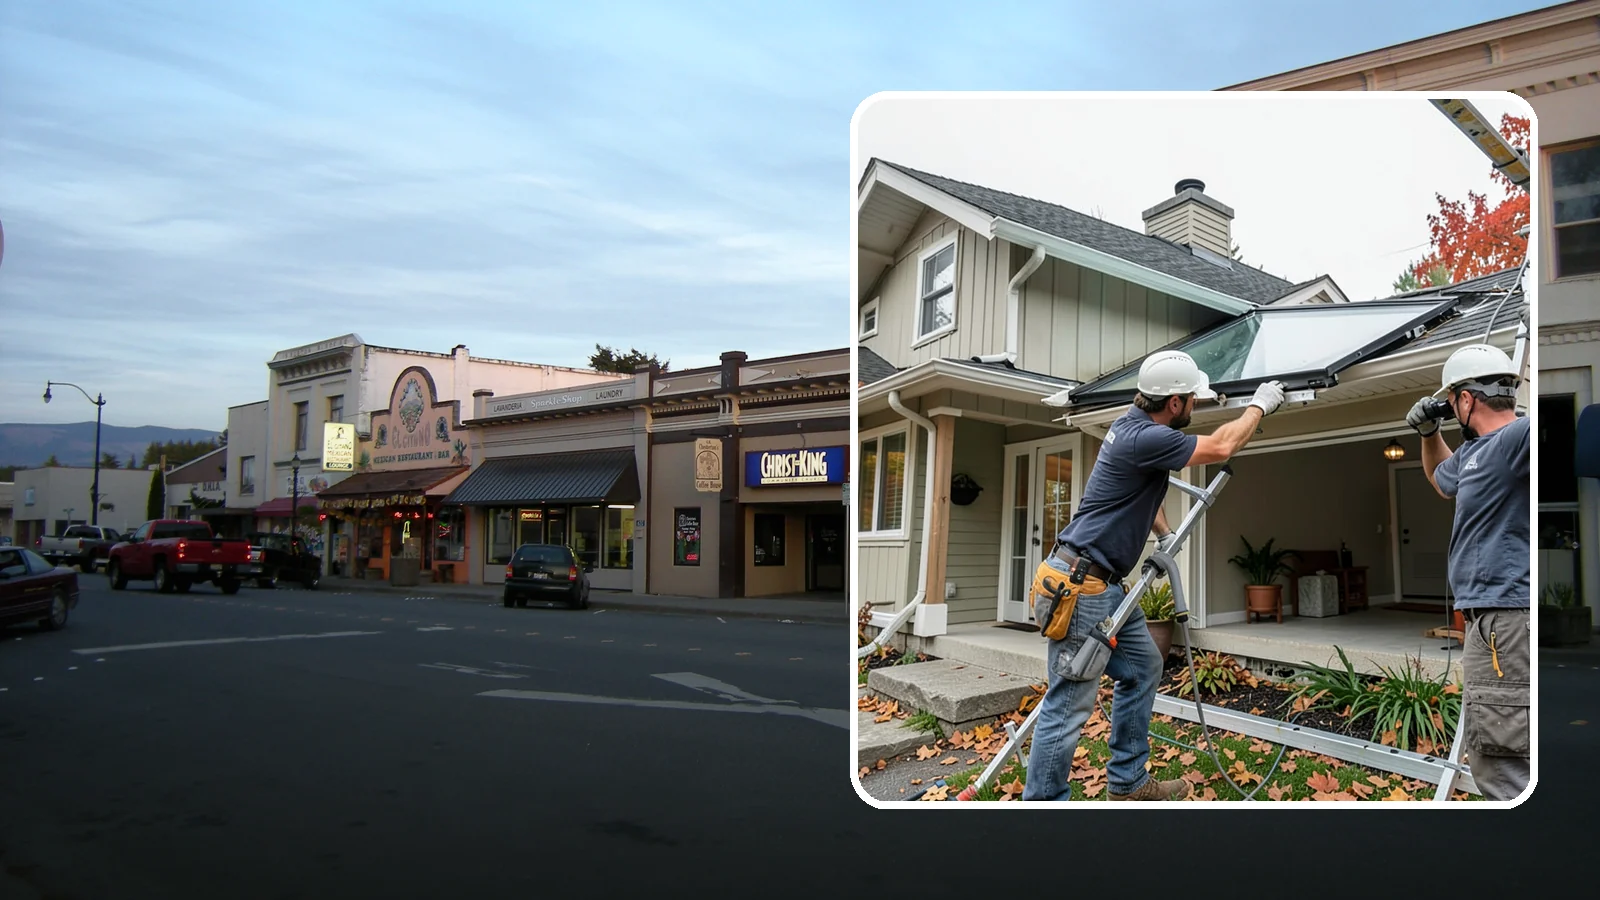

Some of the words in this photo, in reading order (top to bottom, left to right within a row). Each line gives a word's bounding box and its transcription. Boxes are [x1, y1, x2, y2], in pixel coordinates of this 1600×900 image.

[595, 389, 624, 399] LAUNDRY
[561, 395, 583, 405] Shop
[493, 402, 522, 412] LAVANDERIA
[397, 451, 434, 462] RESTAURANT
[438, 450, 450, 459] BAR
[761, 452, 798, 478] CHRIST
[799, 450, 828, 476] KING
